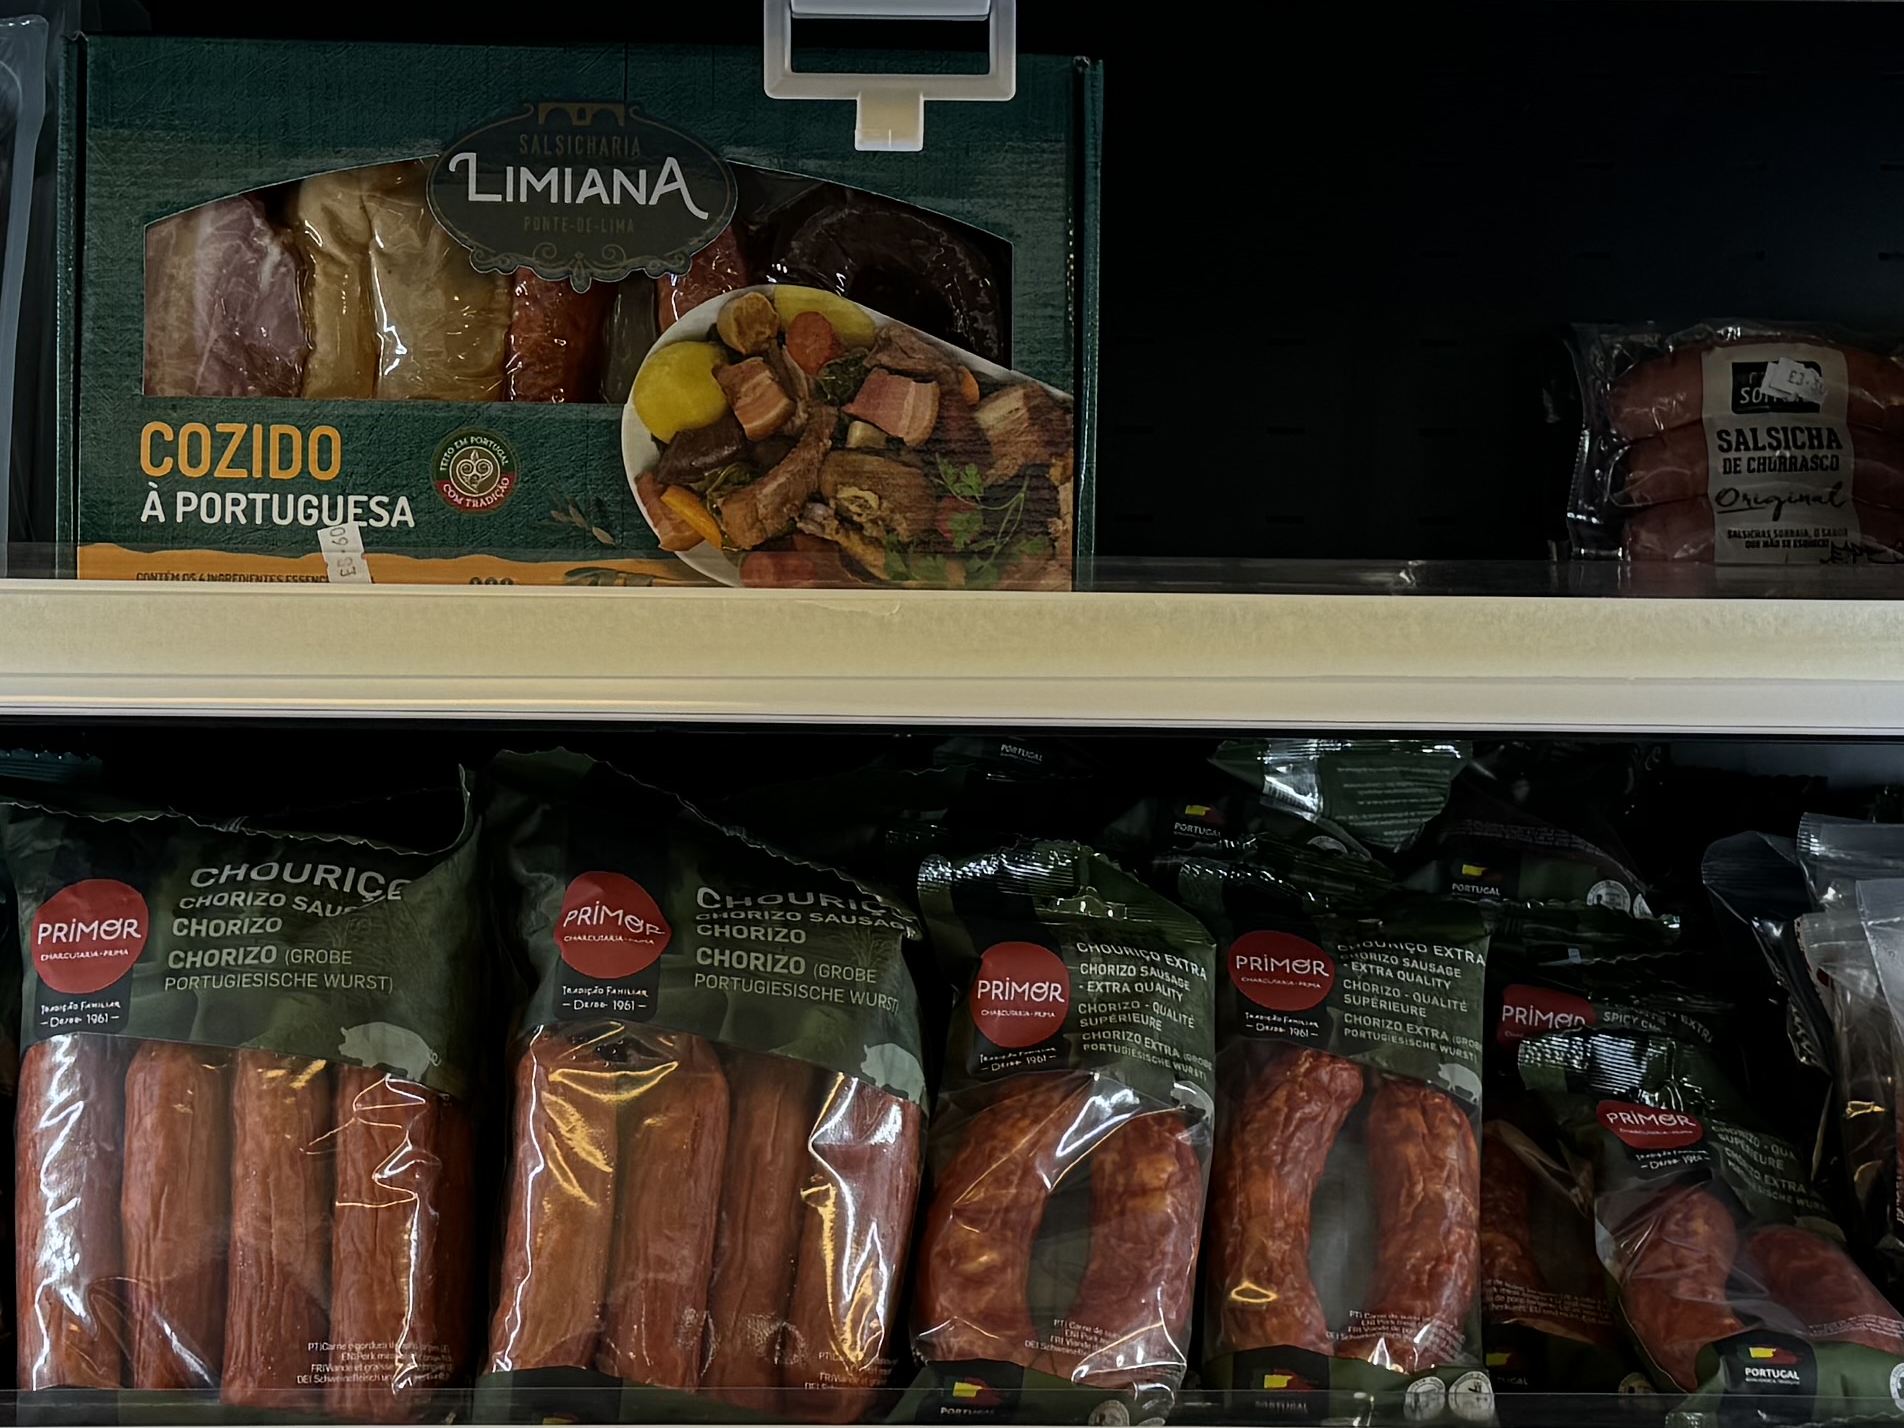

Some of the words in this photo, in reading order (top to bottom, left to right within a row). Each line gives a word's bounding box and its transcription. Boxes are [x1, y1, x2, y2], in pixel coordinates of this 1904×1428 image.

[520, 133, 641, 158] SALSICHARIA
[449, 151, 710, 221] LIMIANA
[523, 216, 636, 236] PONTE-DE-LIMA
[140, 420, 342, 481] COZIDO
[1716, 426, 1843, 453] SALSICHA
[1722, 457, 1742, 475] DE
[1747, 454, 1840, 474] CHURRASCO
[141, 481, 166, 524] À
[176, 491, 416, 529] PORTUGUESA
[442, 483, 464, 506] COM
[465, 476, 510, 508] TRADIÇÃO
[1715, 481, 1847, 521] Original
[178, 890, 287, 911] CHORIZO
[37, 917, 142, 946] PRIMOR
[171, 916, 284, 939] CHORIZO
[696, 922, 808, 946] CHORIZO
[167, 944, 278, 971] CHORIZO
[283, 947, 353, 967] (GROBE
[695, 945, 807, 976] CHORIZO
[812, 962, 878, 985] (GROBE
[1076, 941, 1162, 964] CHOURIÇO
[1163, 953, 1208, 981] EXTRA
[1234, 953, 1331, 978] PRIMOR
[1401, 956, 1462, 979] SAUSAGE
[1432, 944, 1487, 968] EXTRA
[164, 972, 318, 993] PORTUGIESISCHE
[323, 972, 395, 995] WURST)
[693, 972, 845, 1004] PORTUGIESISCHE
[1079, 962, 1138, 978] CHORIZO
[1139, 964, 1192, 993] SAUSAGE
[1351, 961, 1394, 979] EXTRA
[1396, 969, 1452, 991] QUALITY
[976, 976, 1066, 1004] PRIMOR
[1086, 980, 1132, 995] EXTRA
[1133, 981, 1185, 1004] QUALITY
[1342, 978, 1402, 999] CHORIZO
[1412, 991, 1469, 1013] QUALITÉ
[86, 1012, 110, 1025] 1961
[612, 1000, 636, 1012] 1961
[1077, 1000, 1141, 1016] CHORIZO
[1151, 1000, 1197, 1030] QUALITÉ
[1343, 993, 1428, 1018] SUPÉRIEURE
[1079, 1011, 1164, 1033] SUPÉRIEURE
[1343, 1012, 1403, 1033] CHORIZO
[1405, 1023, 1449, 1042] EXTRA
[1081, 1029, 1143, 1047] CHORIZO
[1143, 1036, 1181, 1060] EXTRA
[1343, 1026, 1438, 1053] PORTUGIESISCHE
[1439, 1043, 1479, 1064] WURST)
[1744, 1367, 1801, 1381] PORTUGAL
